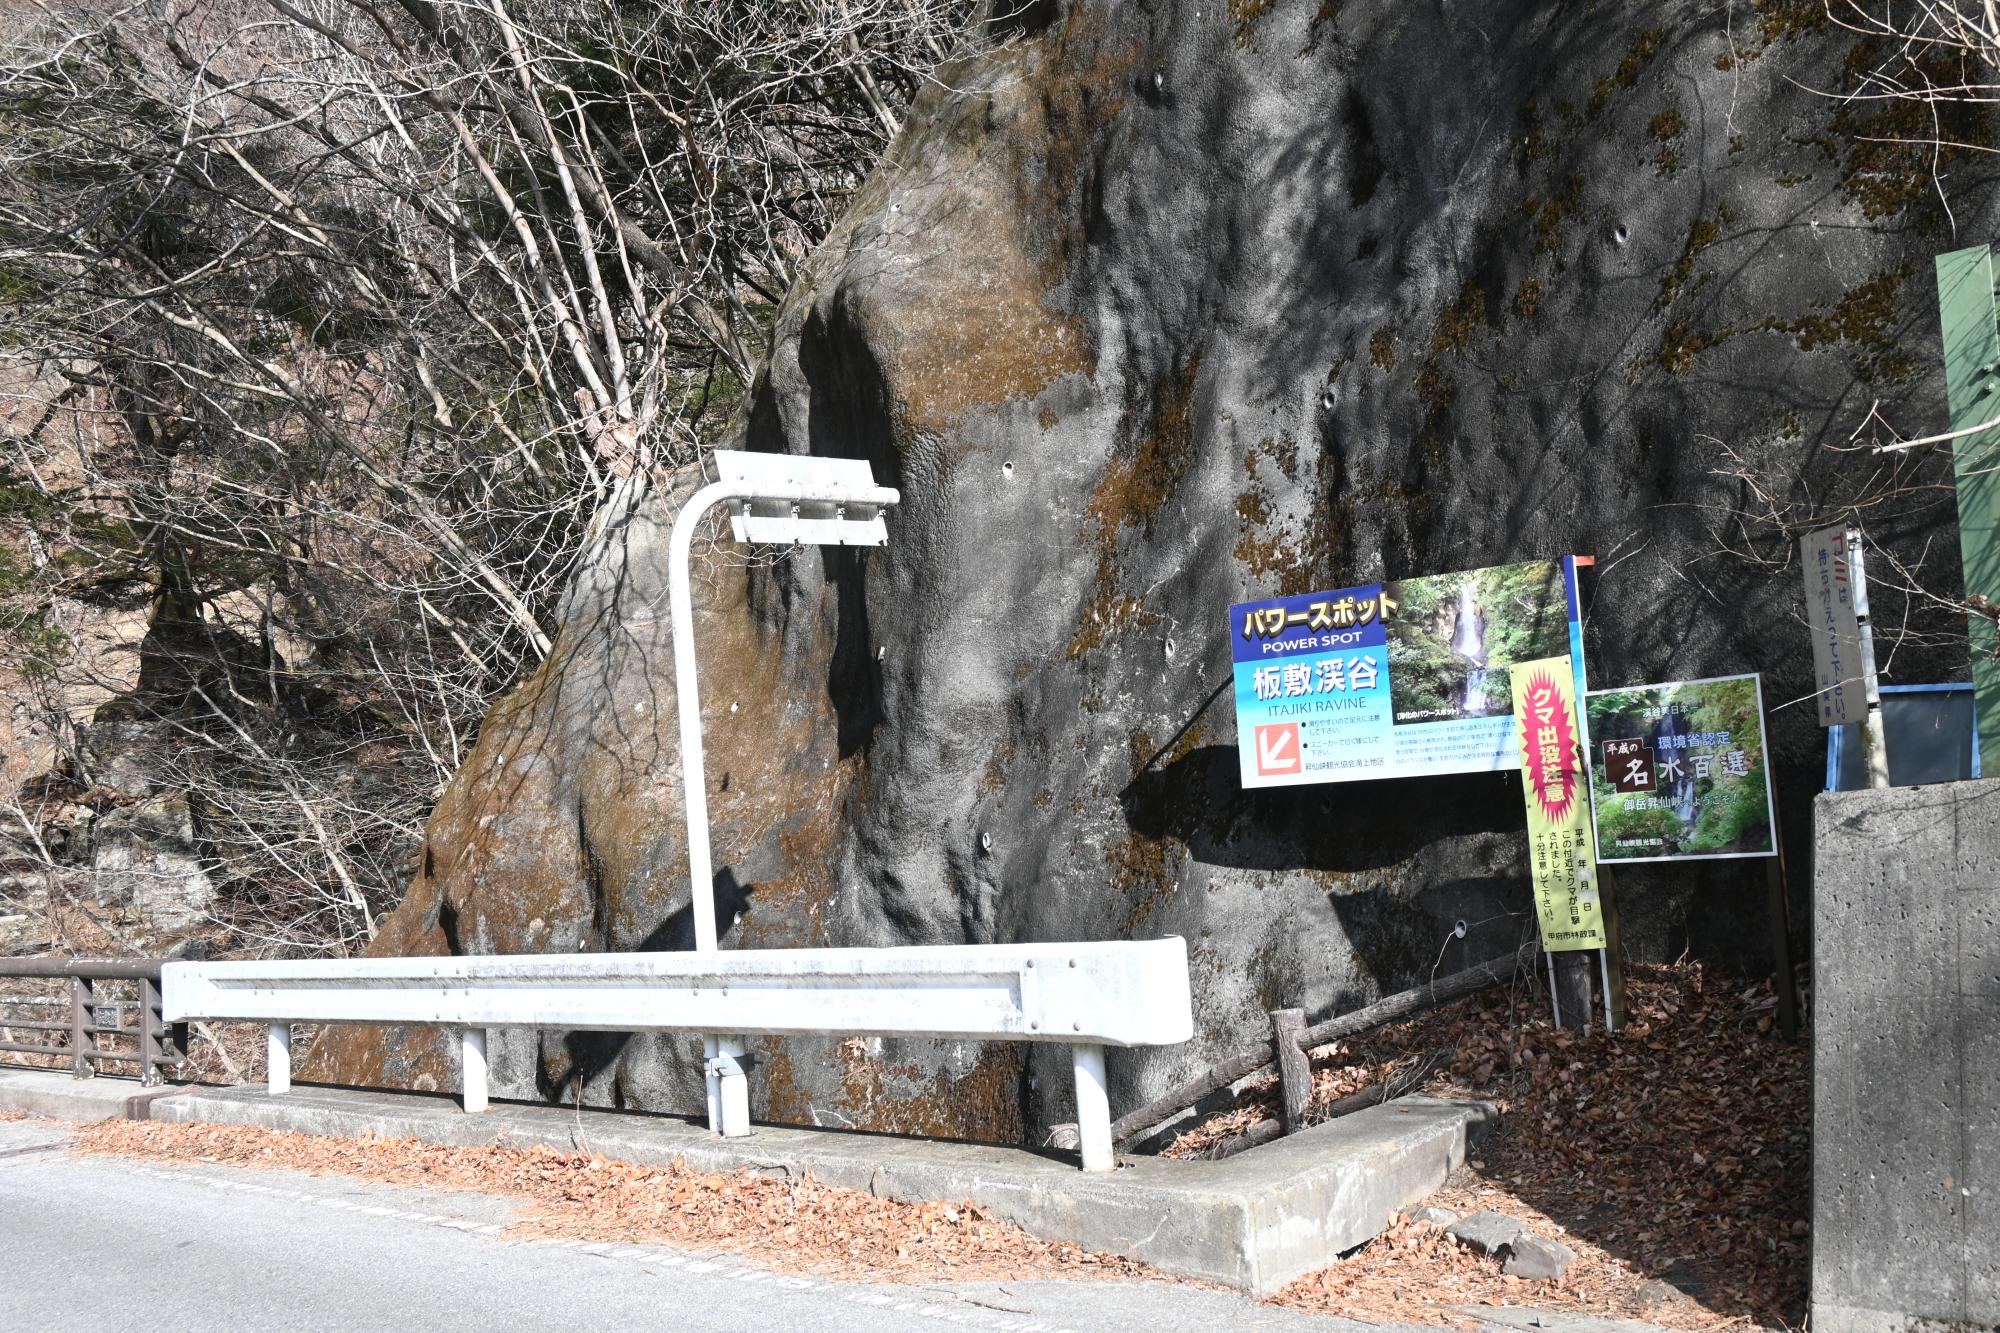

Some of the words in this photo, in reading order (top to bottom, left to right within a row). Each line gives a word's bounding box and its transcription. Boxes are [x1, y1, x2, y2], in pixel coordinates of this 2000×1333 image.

[1242, 591, 1400, 640] パワースポット
[1262, 637, 1318, 653] POWER
[1321, 631, 1363, 646] SPOT
[1253, 655, 1379, 701] 板敷渓谷
[1268, 701, 1312, 717] ITAJIKI
[1315, 696, 1367, 713] RAVINE
[1531, 688, 1566, 804] クマ出没注意
[1607, 742, 1639, 756] 平成の
[1657, 731, 1731, 749] 環境省認定
[1622, 750, 1749, 787] 名水百選
[1574, 829, 1585, 847] 平成
[1549, 831, 1562, 883] されました。
[1578, 860, 1587, 869] 年
[1536, 833, 1554, 921] 十分注意して下さい。
[1562, 830, 1581, 925] この付近でクマが目撃
[1580, 881, 1589, 891] 月
[1583, 902, 1592, 912] 日
[1547, 929, 1597, 941] 甲府市林政課
